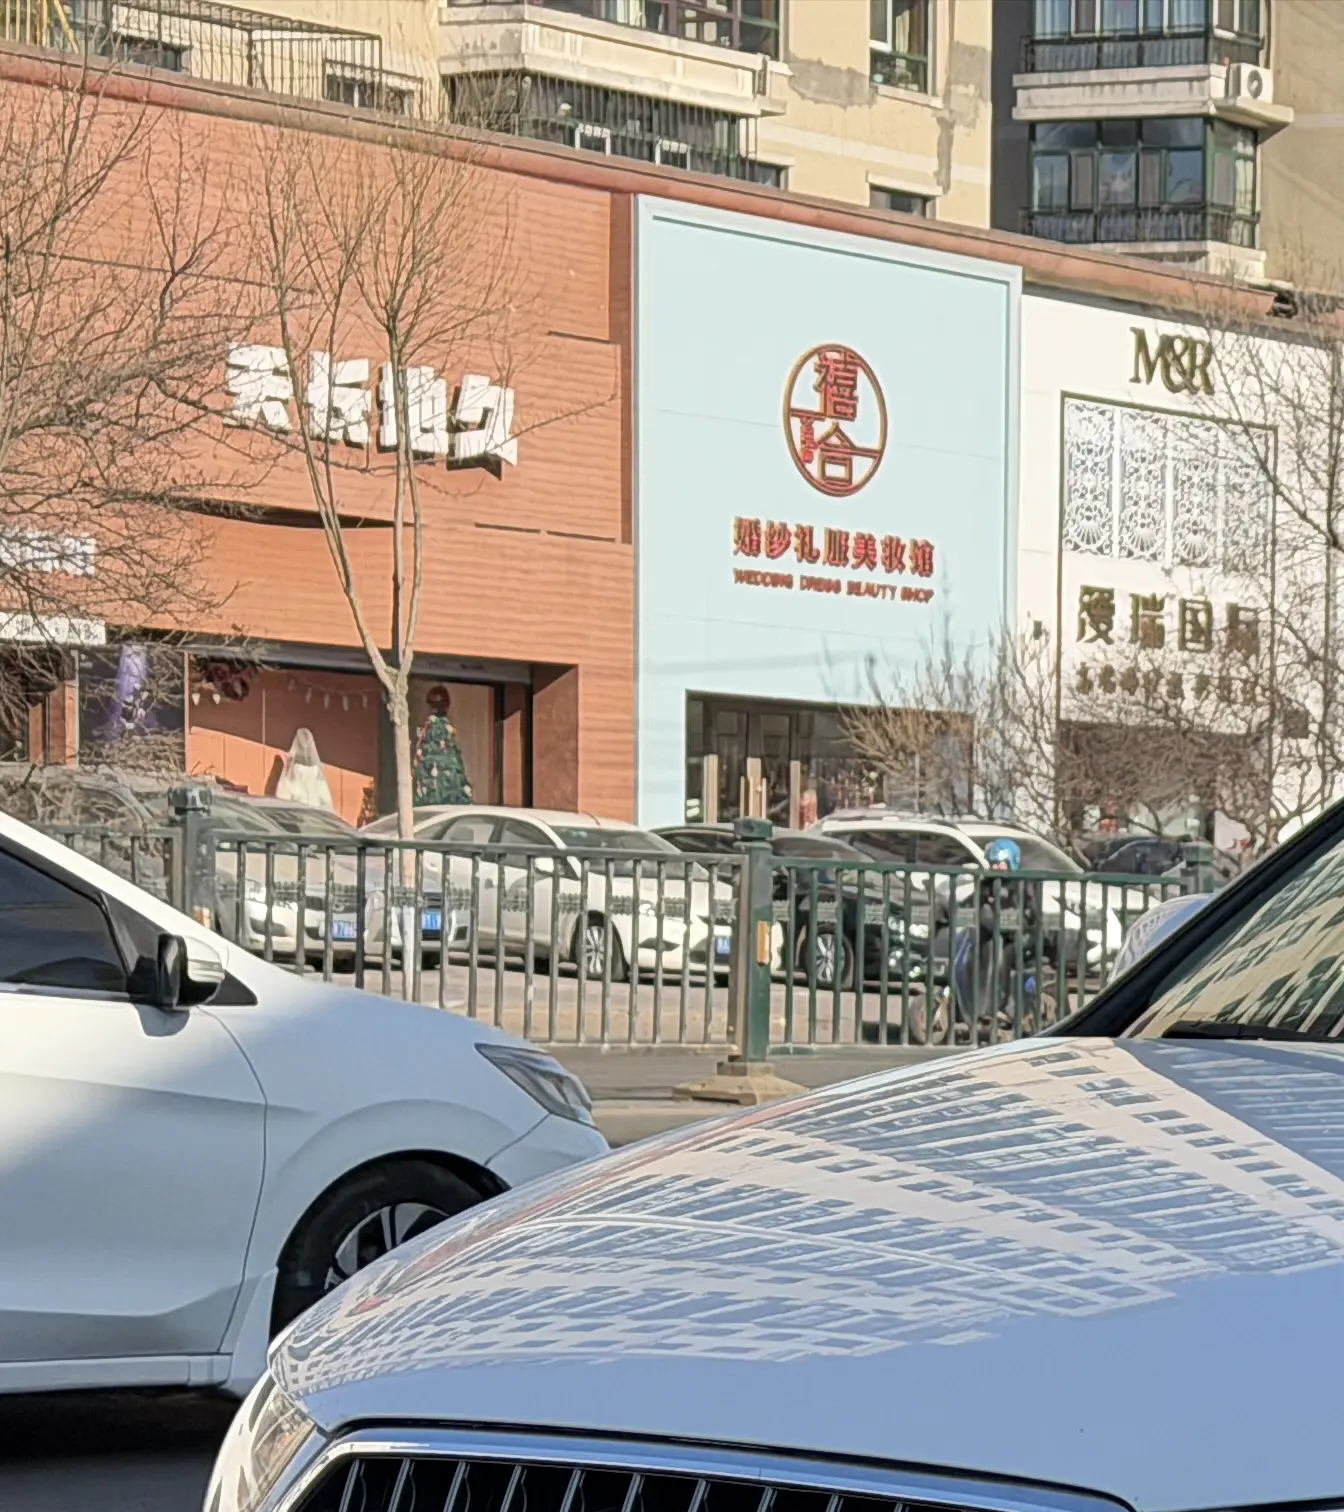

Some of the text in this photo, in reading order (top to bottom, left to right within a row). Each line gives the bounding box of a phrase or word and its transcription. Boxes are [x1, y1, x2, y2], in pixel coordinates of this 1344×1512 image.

[1129, 326, 1215, 396] M&R
[733, 516, 935, 578] 婚纱礼服美妆馆
[733, 567, 794, 590] WEDDING
[846, 580, 897, 601] BEAUTY
